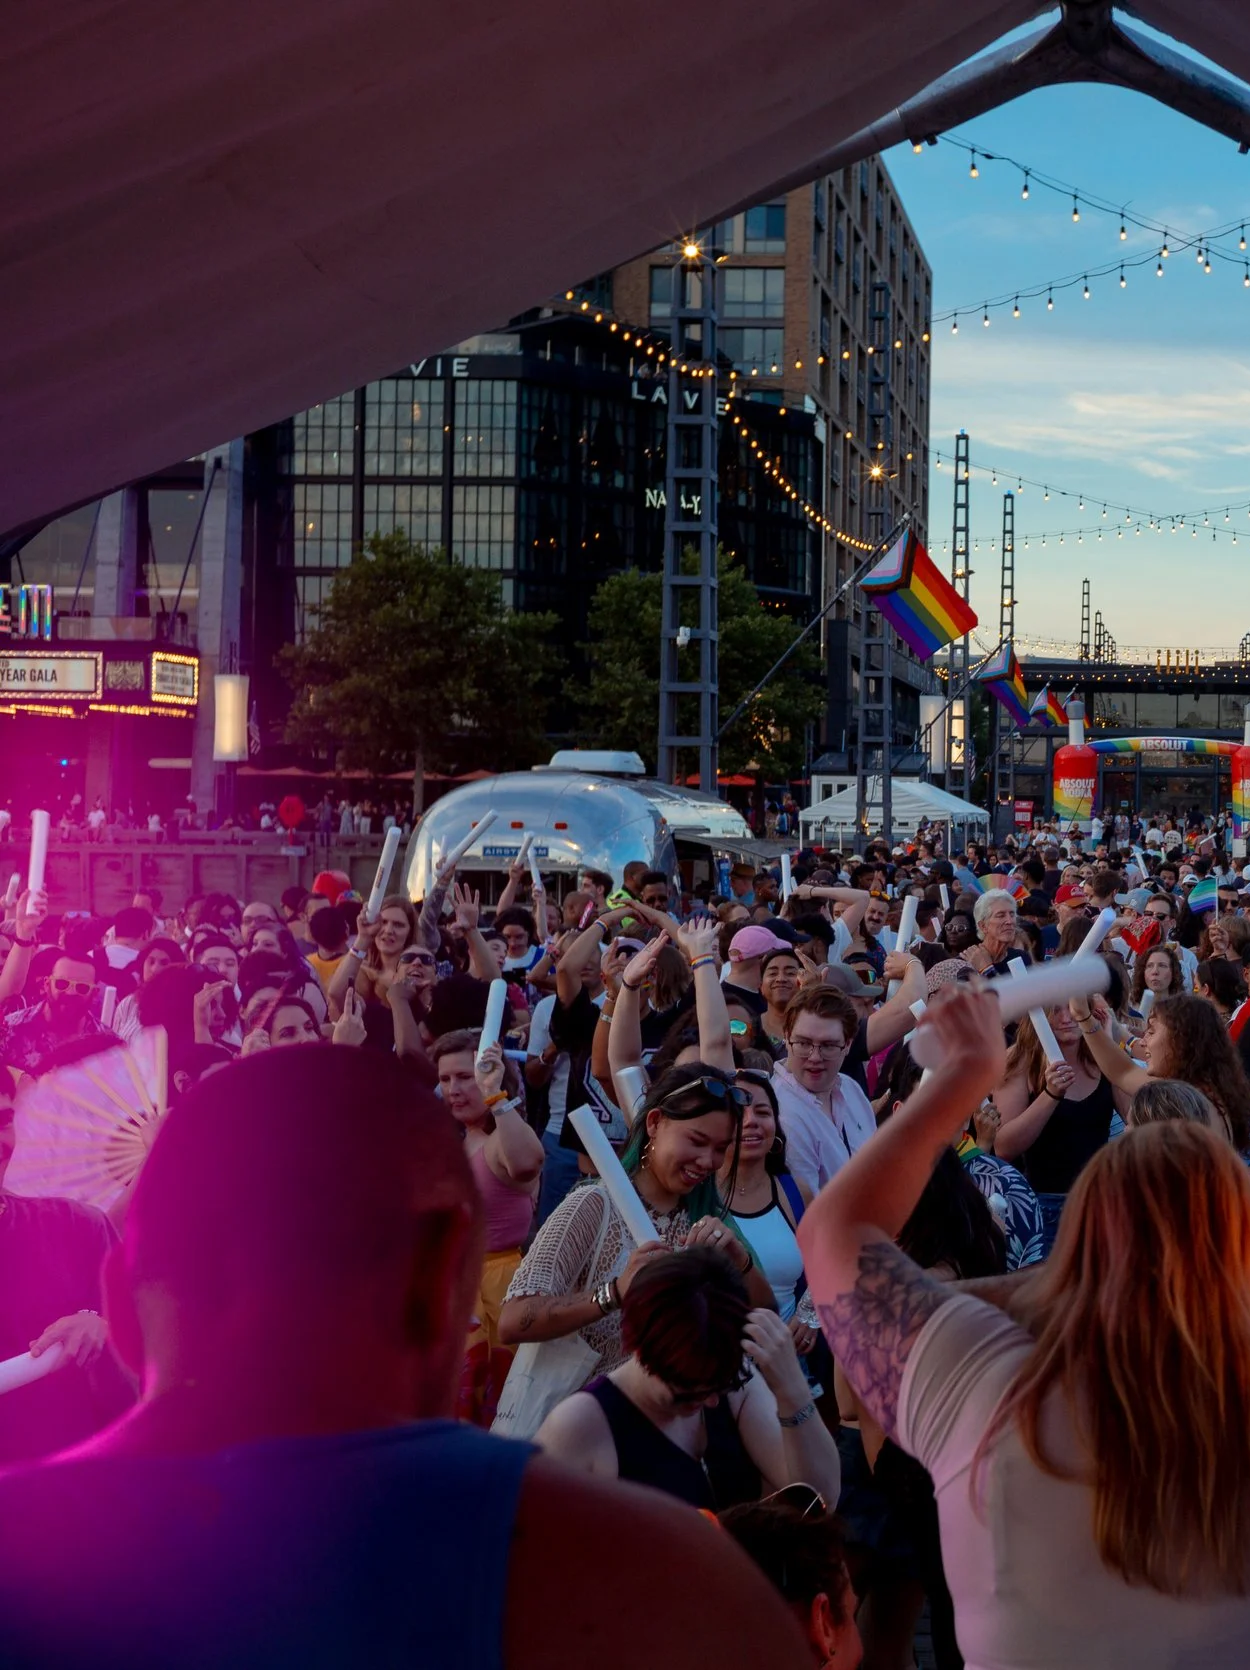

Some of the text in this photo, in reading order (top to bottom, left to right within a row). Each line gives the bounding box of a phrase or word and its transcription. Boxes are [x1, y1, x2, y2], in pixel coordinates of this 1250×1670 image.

[410, 358, 470, 377] VIE
[631, 381, 728, 416] LA VE
[0, 668, 58, 682] YEAR GALA
[1139, 739, 1188, 751] ABSOLUT
[1059, 778, 1095, 788] ABSOLUT
